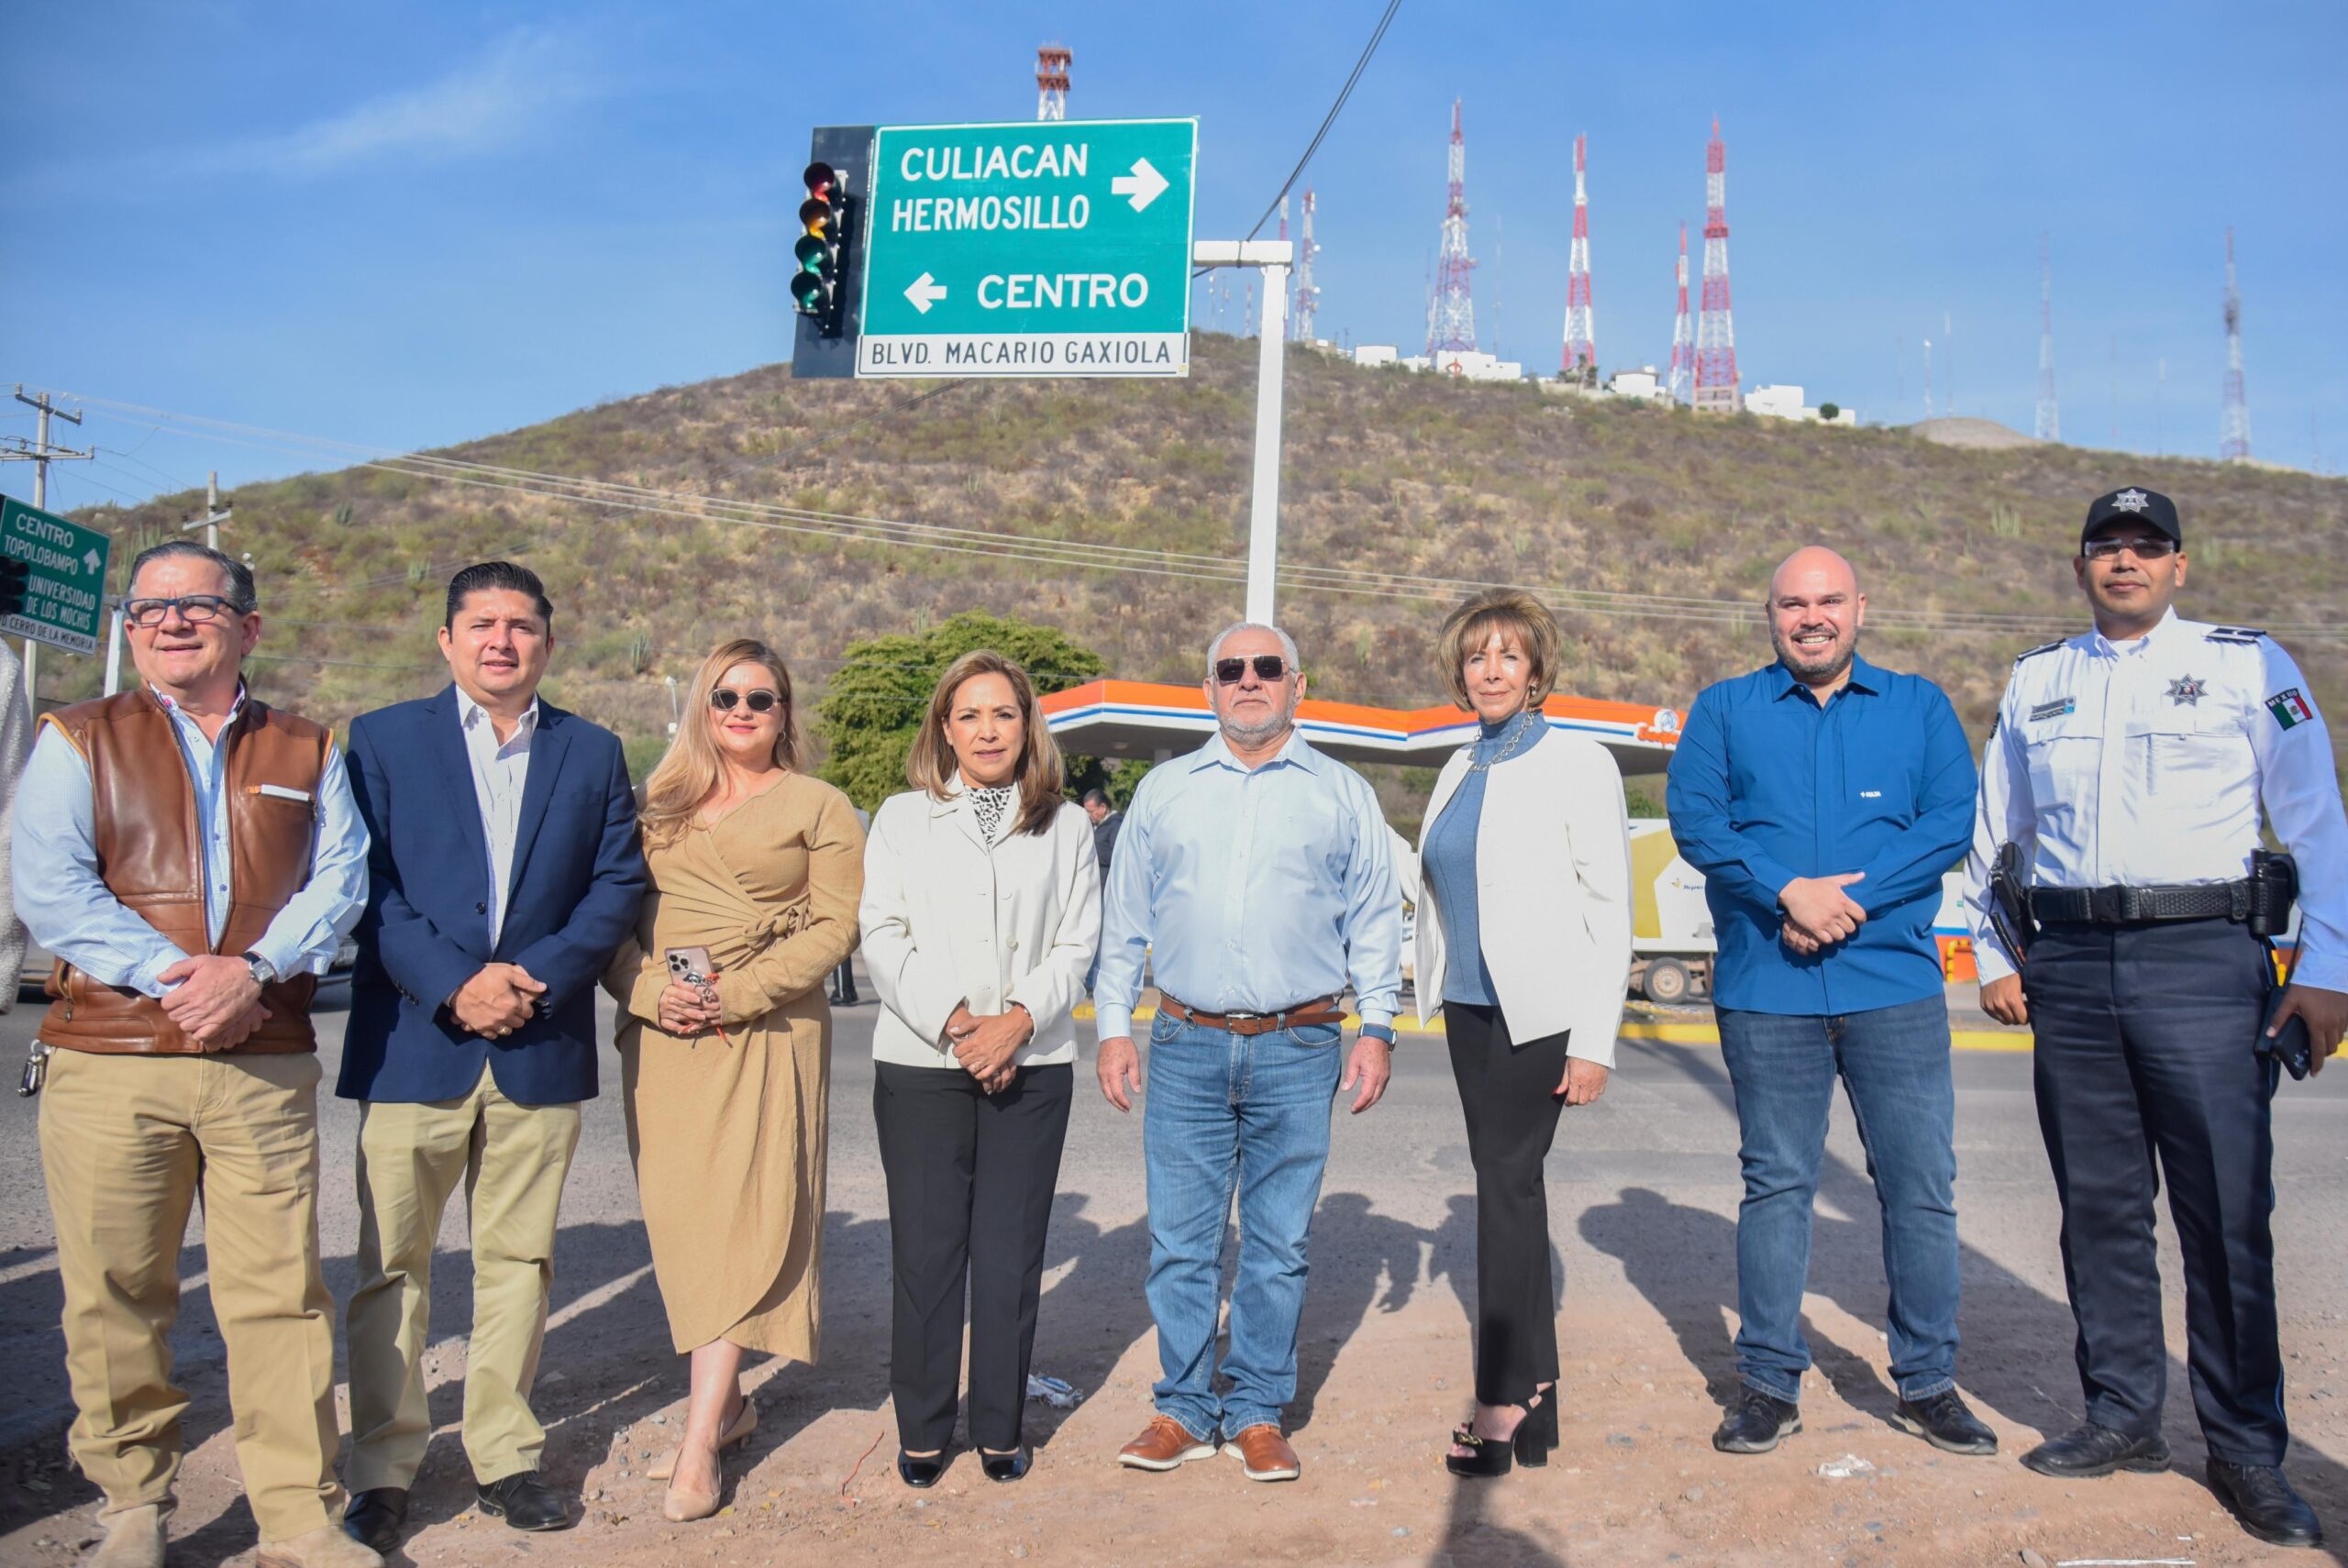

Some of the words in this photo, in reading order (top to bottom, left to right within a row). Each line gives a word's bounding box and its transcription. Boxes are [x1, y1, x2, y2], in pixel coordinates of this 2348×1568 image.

[901, 143, 1089, 182] CULIACAN
[892, 194, 1091, 232] HERMOSILLO
[977, 272, 1149, 309] CENTRO
[871, 342, 932, 365] BLVD.
[945, 341, 1055, 364] MACARIO
[1064, 340, 1171, 364] GAXIOLA
[16, 513, 75, 548] CENTRO
[4, 534, 79, 576] TOPOLOBAMPO
[28, 574, 96, 611] UNIVERSIDAD
[9, 616, 37, 635] CERRO
[26, 595, 39, 615] DE
[40, 600, 58, 621] LOS
[59, 605, 92, 631] MOCHIS
